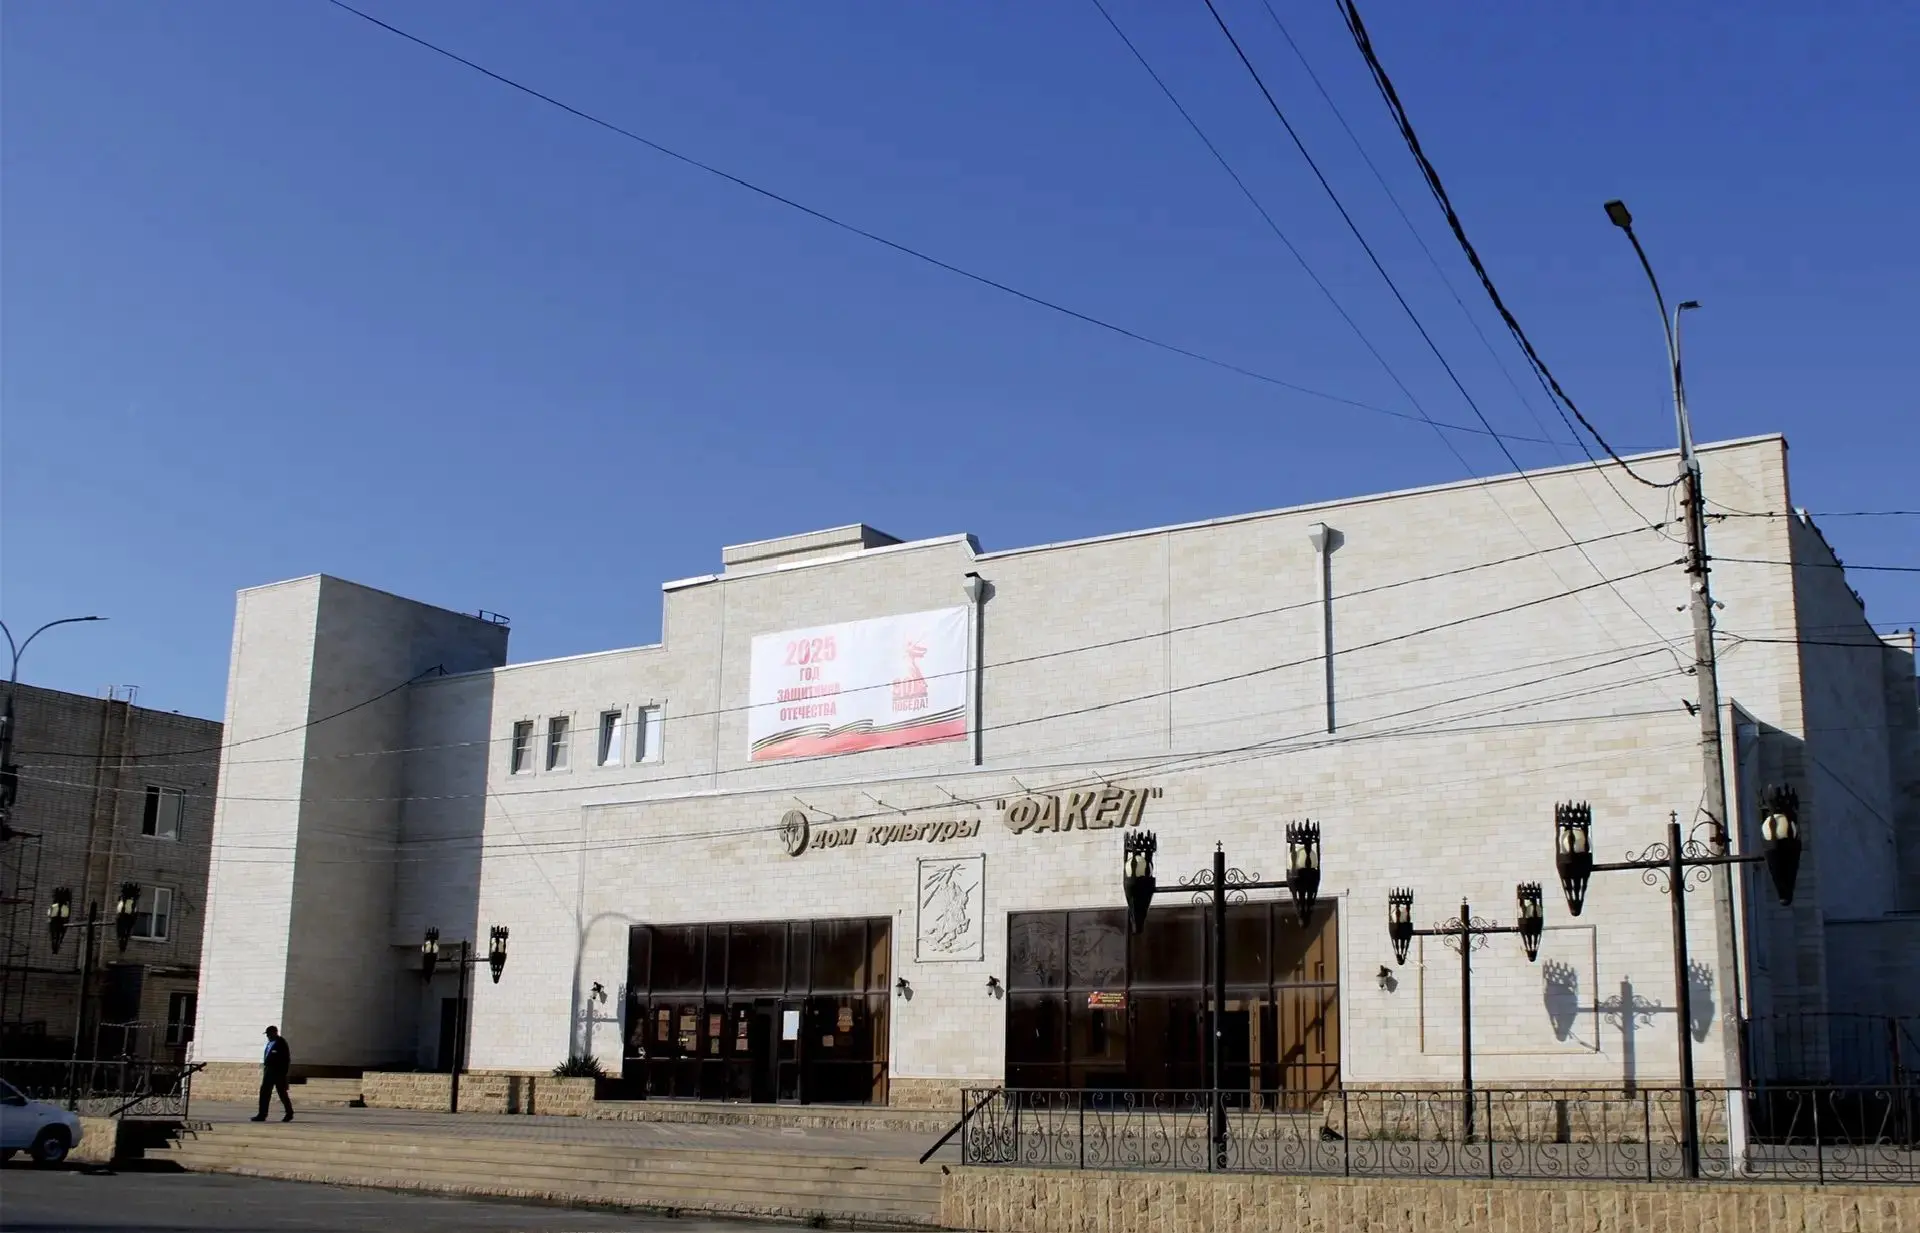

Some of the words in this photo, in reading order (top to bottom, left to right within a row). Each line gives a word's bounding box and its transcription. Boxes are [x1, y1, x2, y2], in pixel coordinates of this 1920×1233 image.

[785, 636, 837, 664] 2025
[800, 667, 820, 682] ГОД
[780, 701, 837, 721] ОТЕЧЕСТВА
[892, 698, 928, 712] ПОБЕДА!
